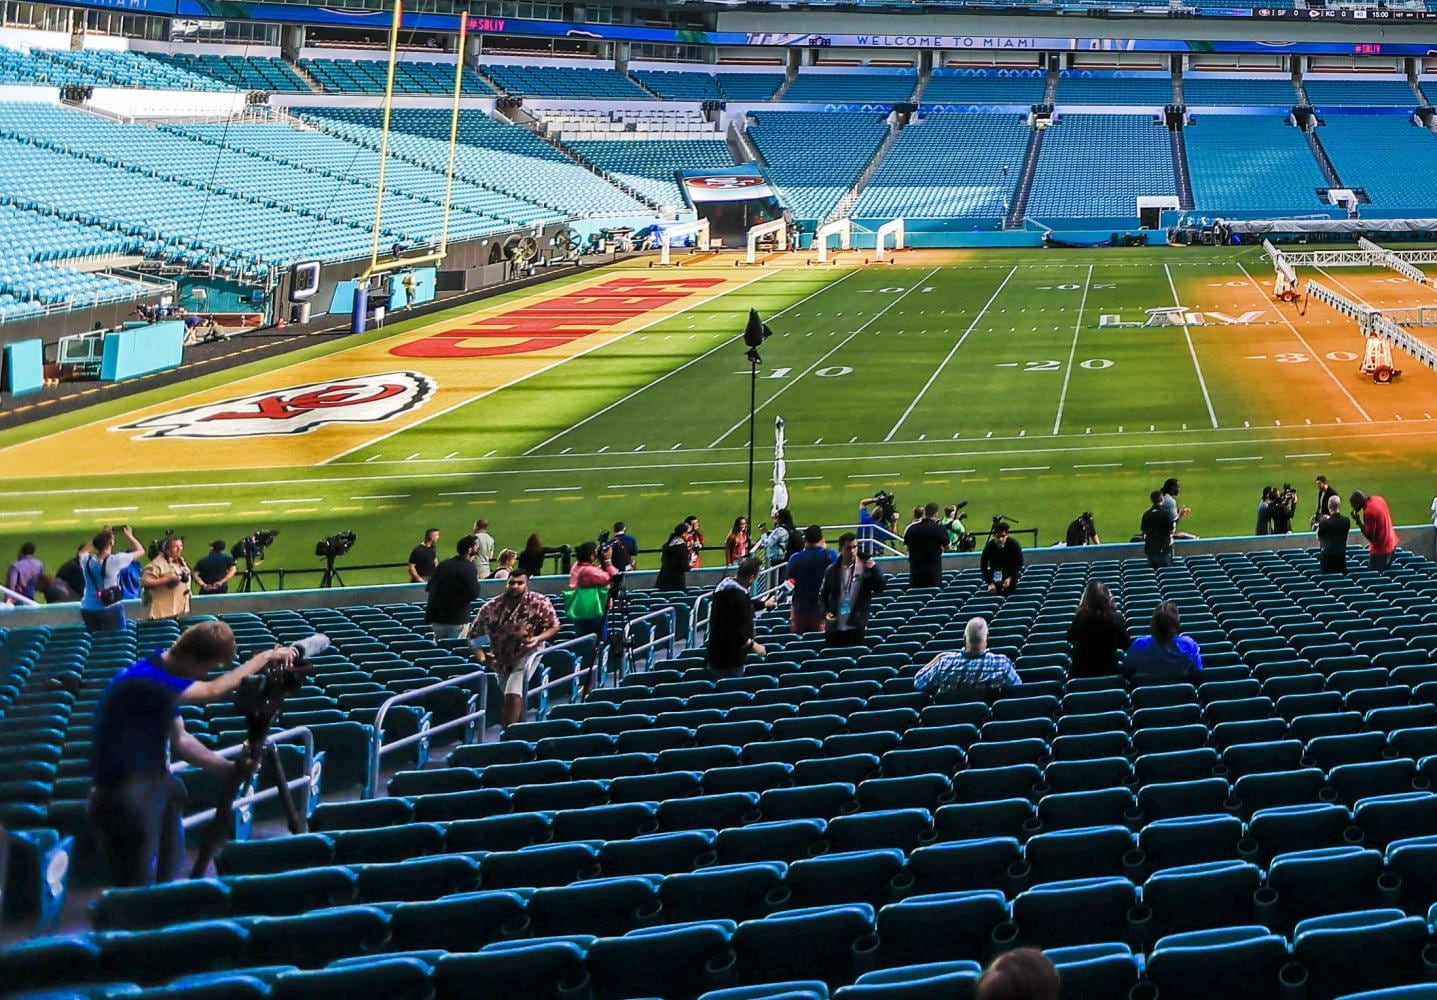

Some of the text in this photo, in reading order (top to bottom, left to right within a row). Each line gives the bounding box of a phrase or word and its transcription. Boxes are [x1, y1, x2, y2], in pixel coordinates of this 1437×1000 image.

[468, 20, 504, 31] #SBLIV
[857, 35, 1036, 48] WELCOME TO MIAMI
[389, 278, 727, 357] CHIEFS
[1274, 351, 1358, 364] 30
[1023, 359, 1114, 372] 20
[760, 366, 854, 379] 10
[197, 384, 406, 420] KC
